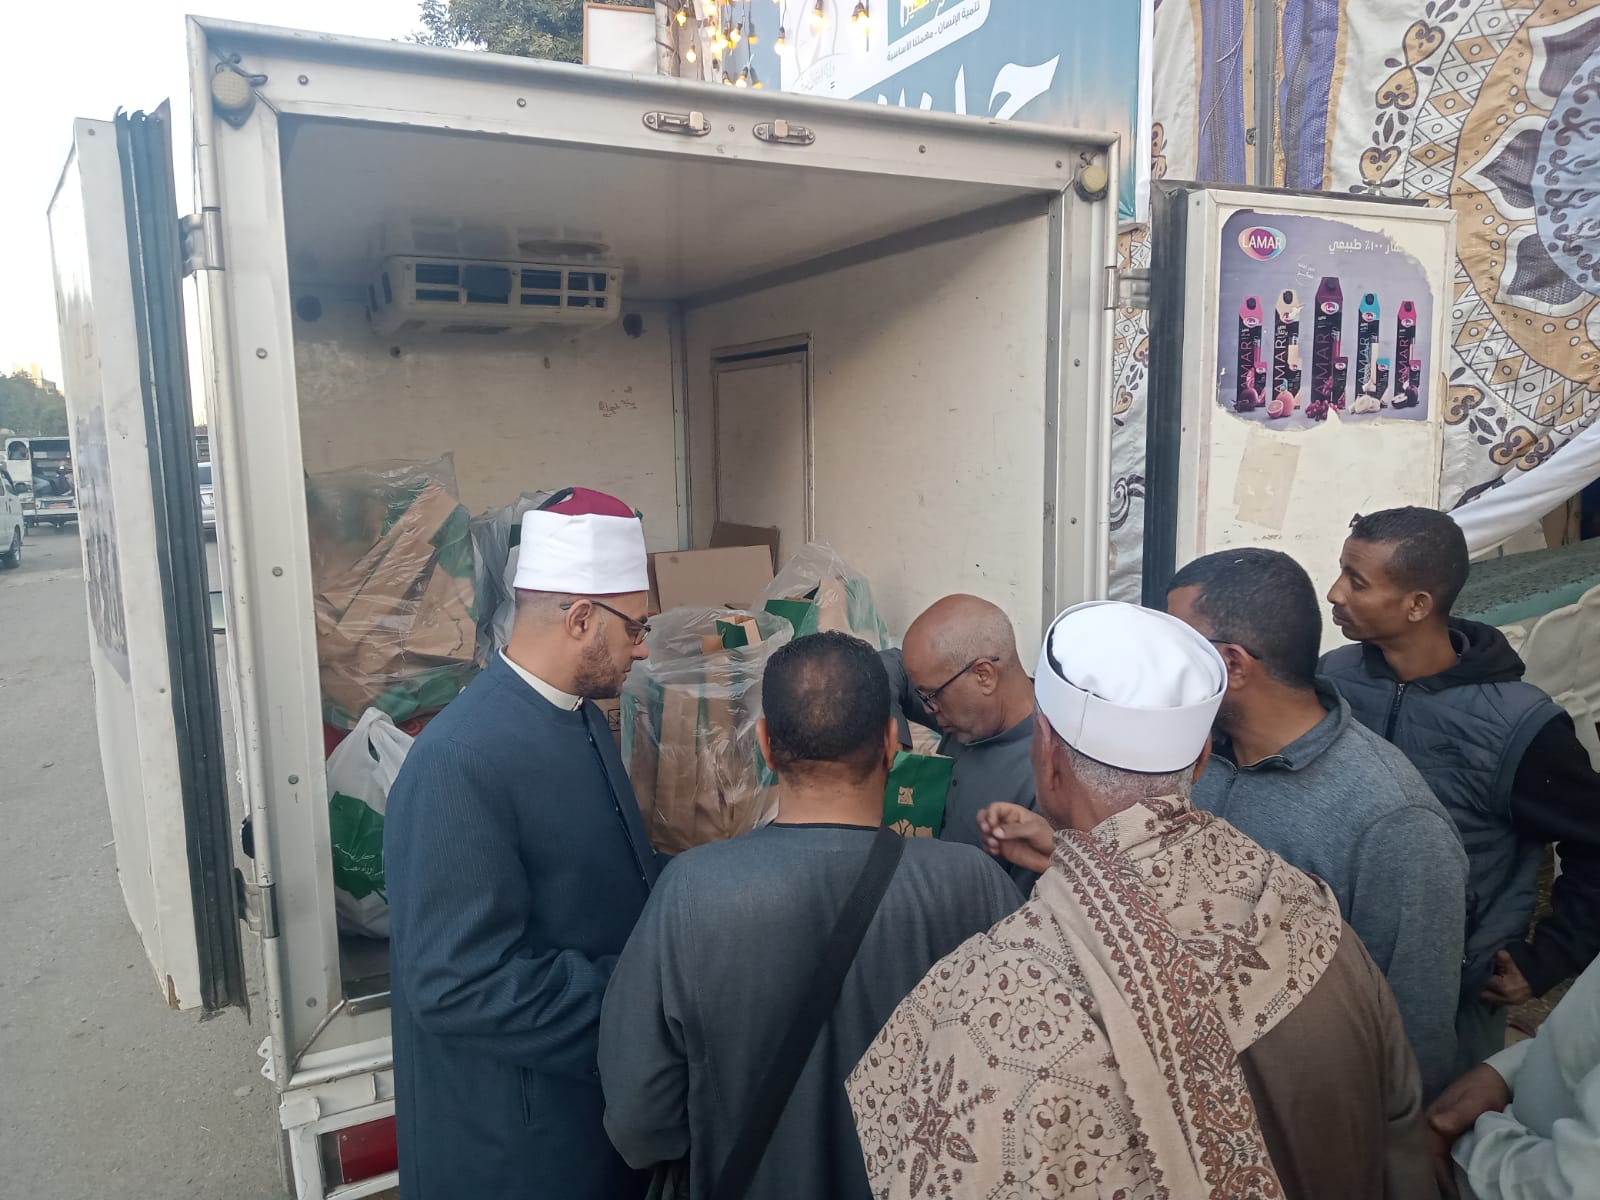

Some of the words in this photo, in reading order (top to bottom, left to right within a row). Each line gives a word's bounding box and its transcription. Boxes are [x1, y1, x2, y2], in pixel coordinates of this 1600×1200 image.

[961, 1, 980, 20] تنمية
[912, 30, 934, 48] مهمتنا
[1242, 234, 1283, 250] LAMAR
[1328, 238, 1362, 255] طبيعي
[1240, 341, 1252, 388] AMAR
[1274, 338, 1287, 392] AMAR
[1314, 332, 1331, 395] AMAR
[1397, 338, 1410, 384] AMAR
